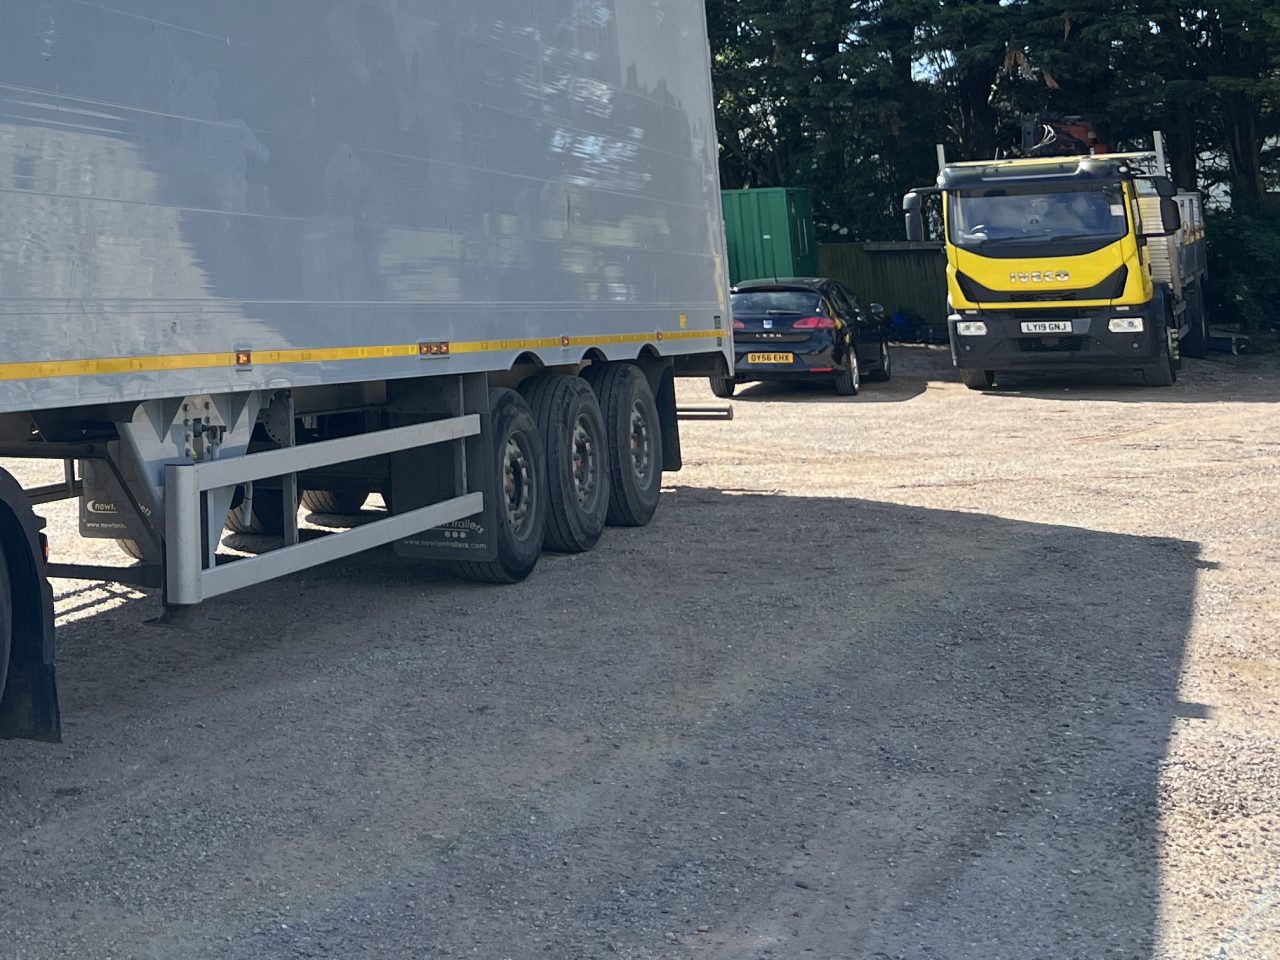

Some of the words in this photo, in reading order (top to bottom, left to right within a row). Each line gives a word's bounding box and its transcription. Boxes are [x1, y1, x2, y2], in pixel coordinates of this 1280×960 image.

[1010, 270, 1070, 283] IVECO
[1026, 323, 1047, 331] LY19
[1048, 323, 1067, 331] GNJ
